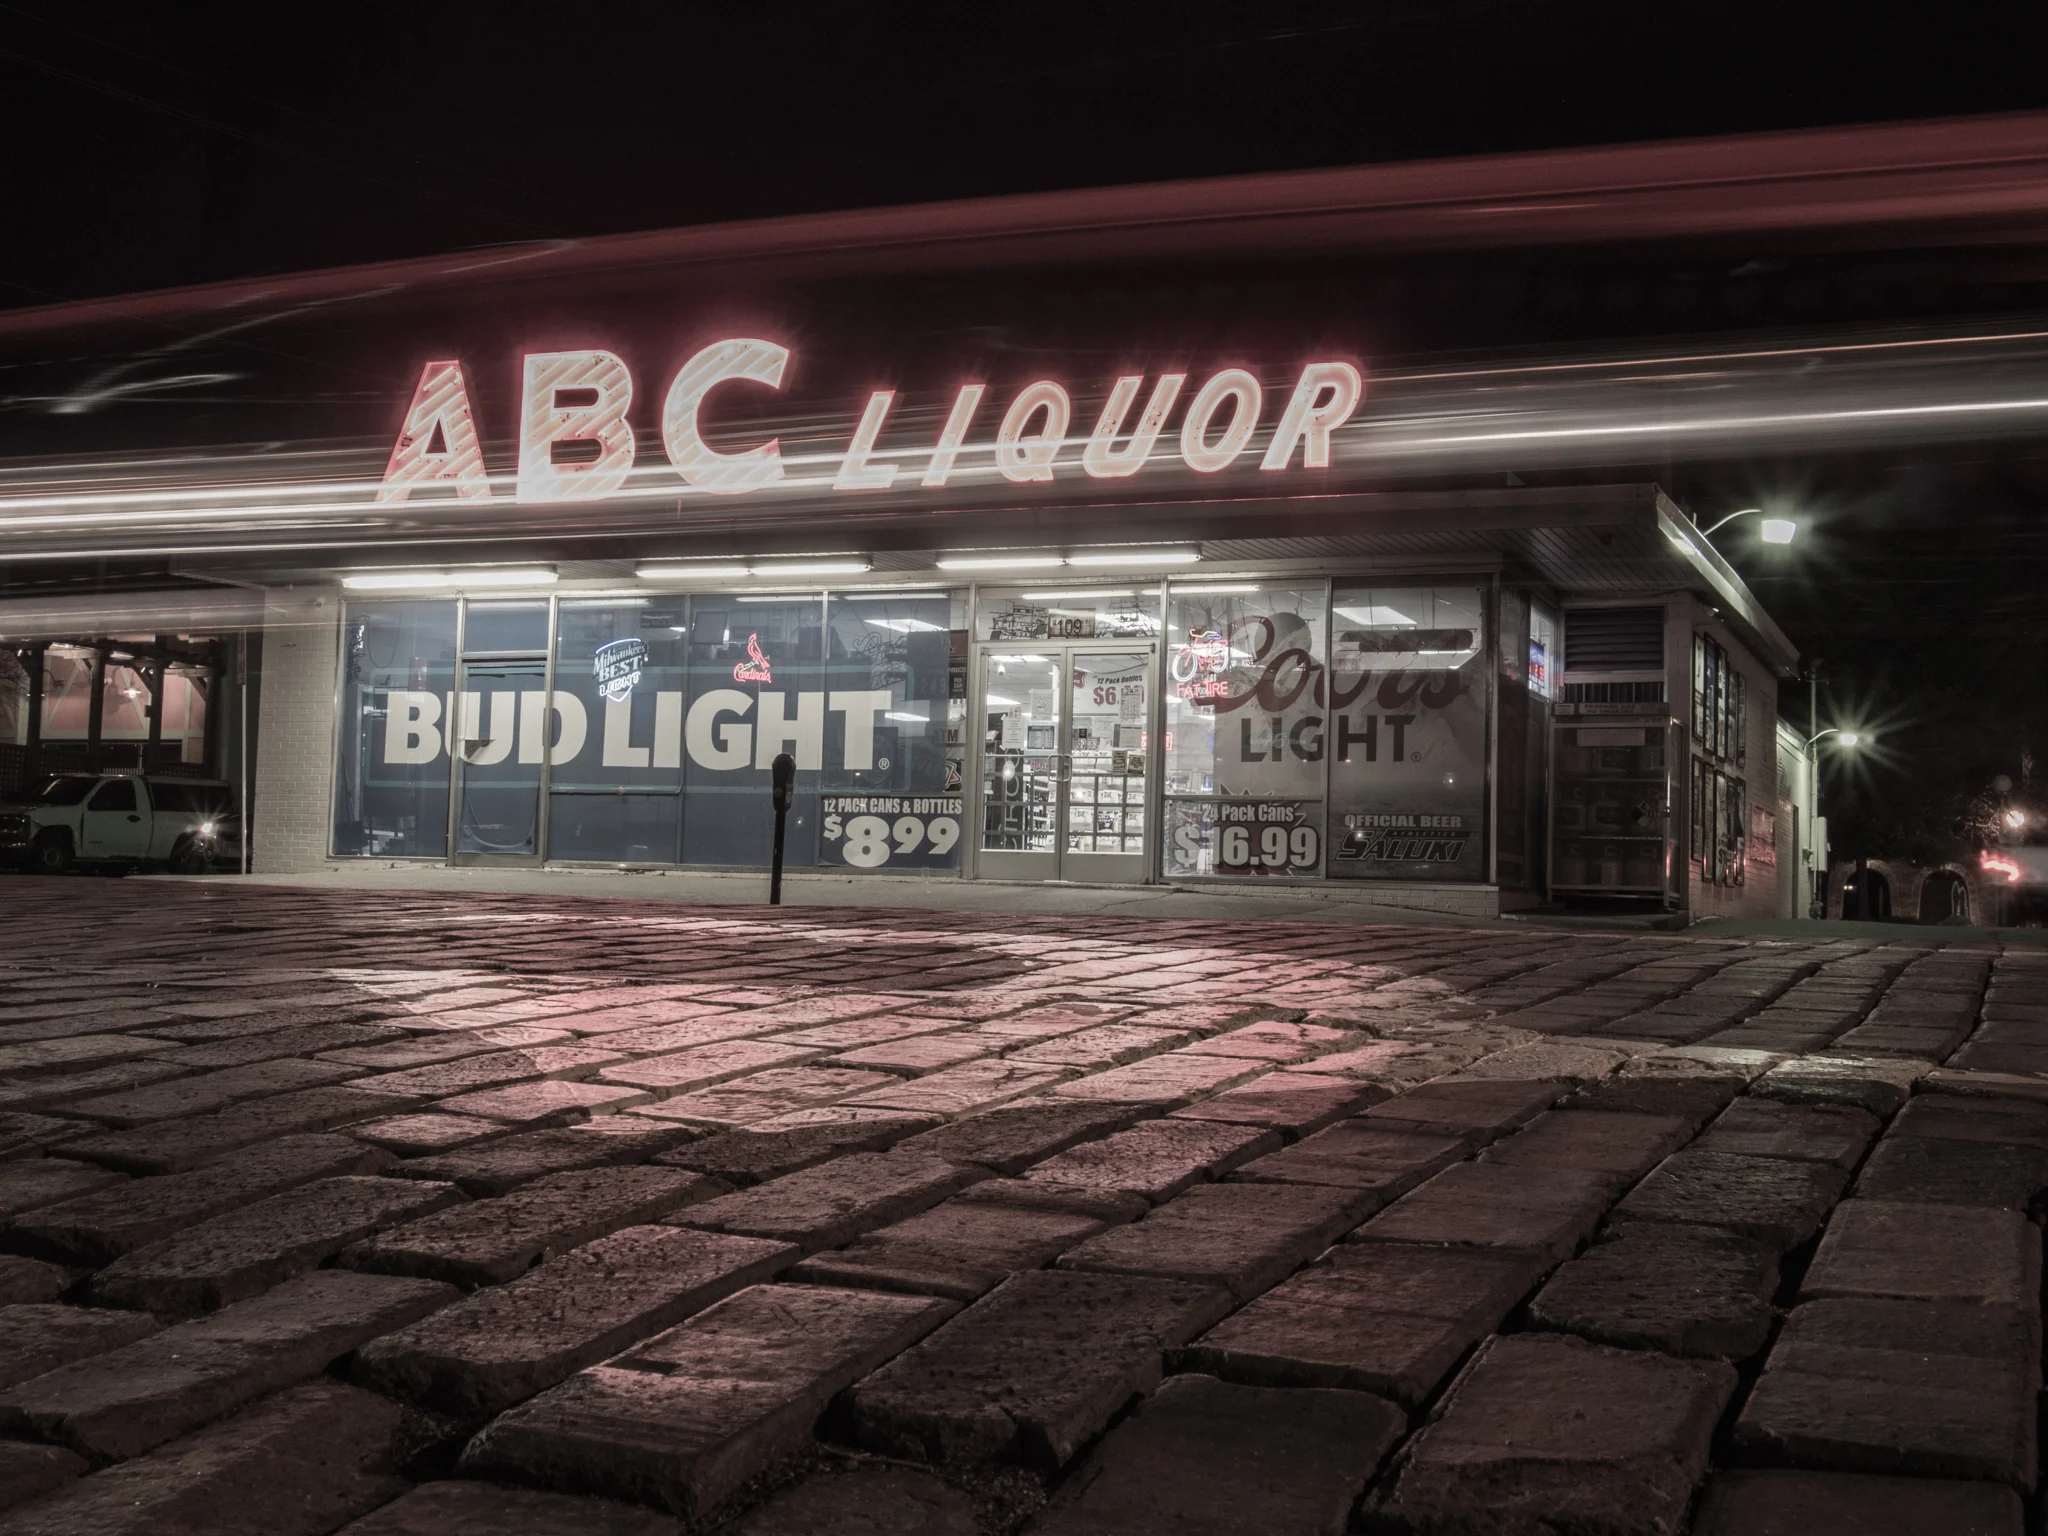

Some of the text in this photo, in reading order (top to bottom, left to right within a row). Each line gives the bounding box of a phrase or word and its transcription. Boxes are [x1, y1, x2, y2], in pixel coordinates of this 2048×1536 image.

[376, 339, 1363, 505] ABC LIQUOR
[598, 655, 642, 683] BEST
[733, 663, 772, 684] Cardinals
[1193, 615, 1476, 714] Coors
[599, 671, 641, 698] LIGHT
[1176, 681, 1229, 698] FAT TIRE
[385, 689, 893, 771] BUD LIGHT
[1241, 715, 1417, 762] LIGHT
[824, 798, 963, 815] 12 PACK CANS & BOTTLES
[1201, 804, 1295, 823] 24 Pack Cans
[1344, 815, 1462, 829] OFFICIAL BEER
[1174, 822, 1318, 868] $16.99
[1336, 829, 1466, 862] SALUKI
